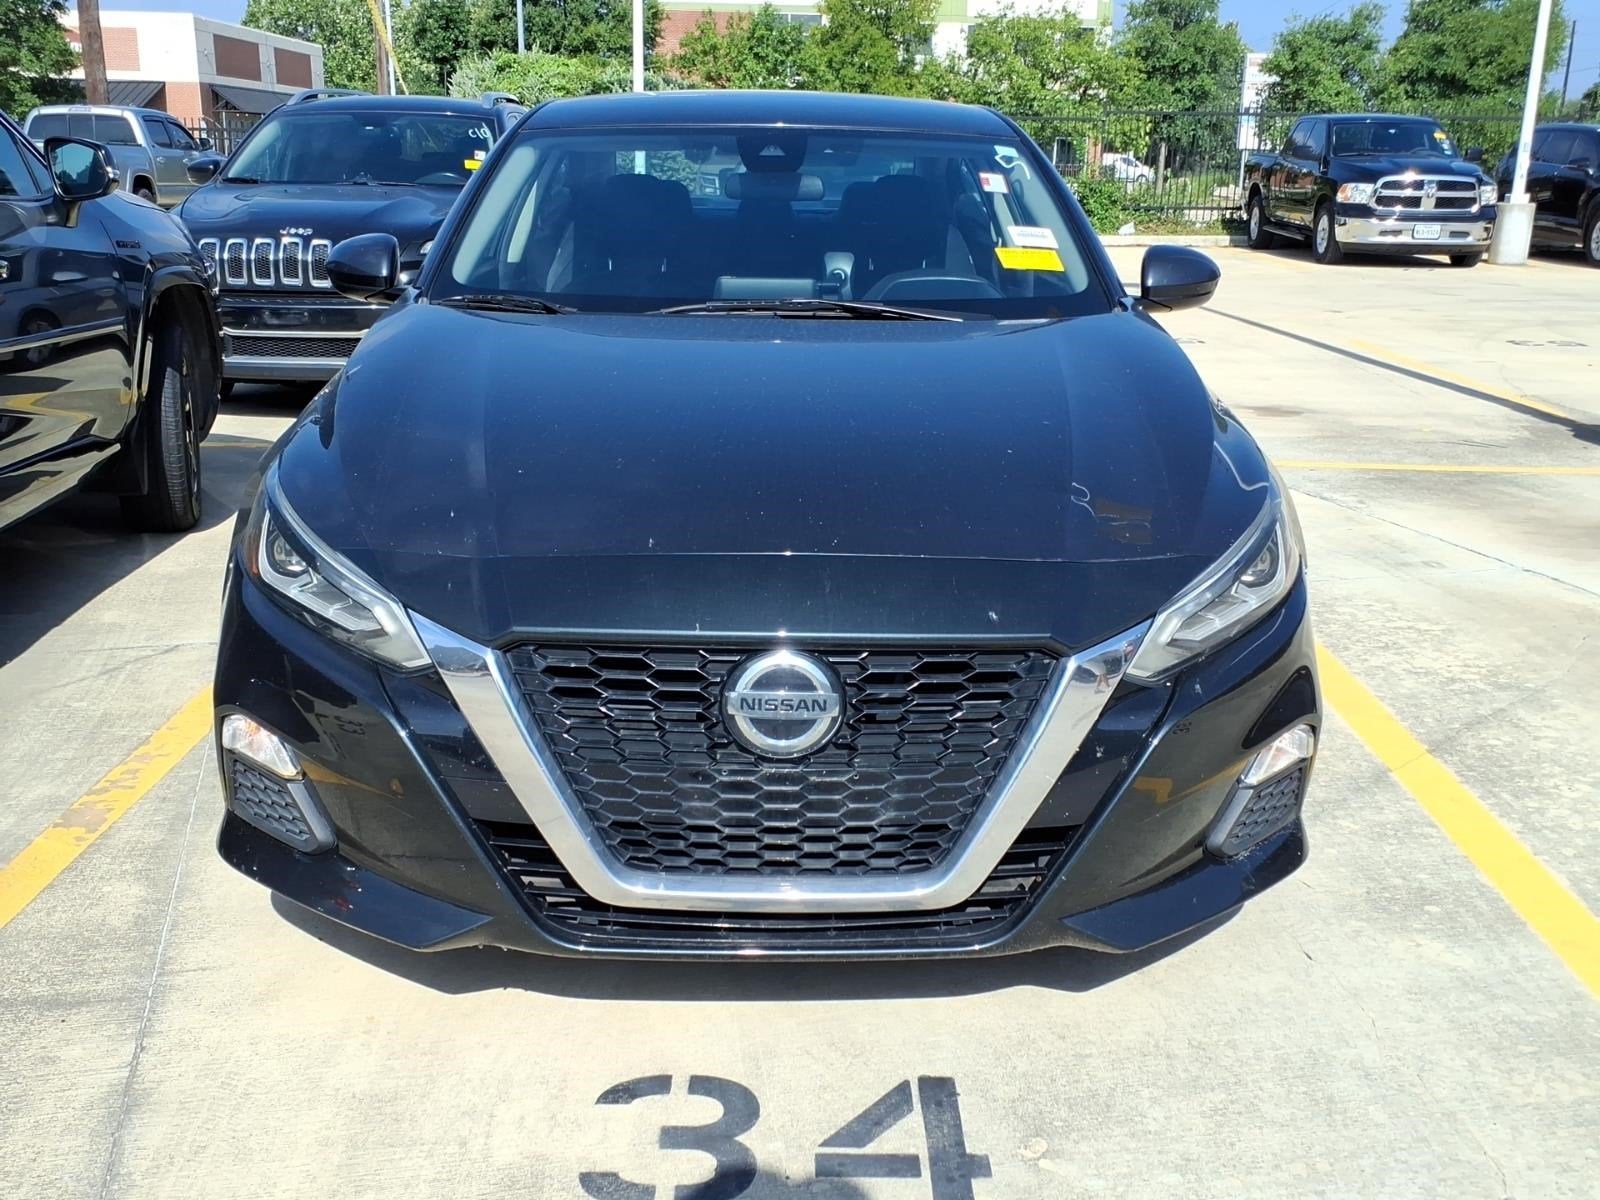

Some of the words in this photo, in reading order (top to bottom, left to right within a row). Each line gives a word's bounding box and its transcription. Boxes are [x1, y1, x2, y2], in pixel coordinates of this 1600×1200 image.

[279, 226, 314, 236] Jeep
[740, 697, 827, 712] NISSAN
[578, 1074, 993, 1200] 34
